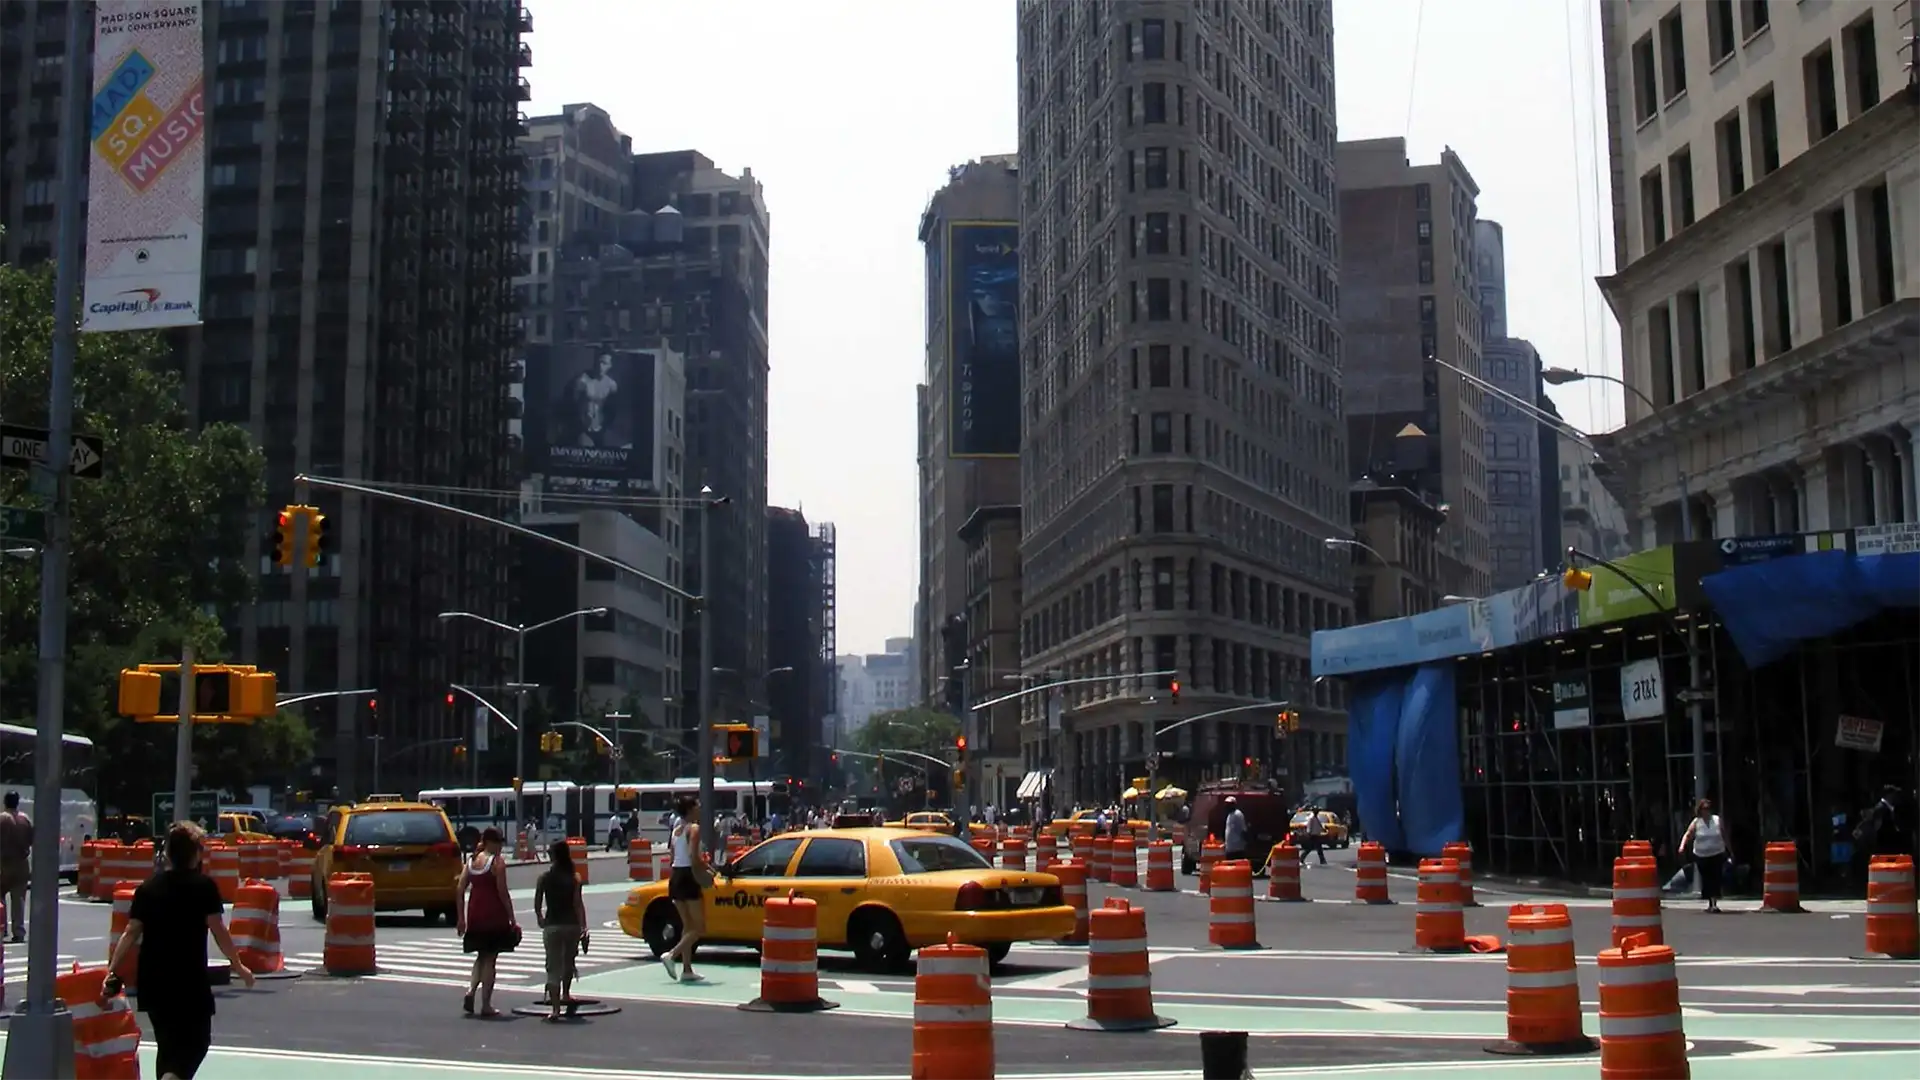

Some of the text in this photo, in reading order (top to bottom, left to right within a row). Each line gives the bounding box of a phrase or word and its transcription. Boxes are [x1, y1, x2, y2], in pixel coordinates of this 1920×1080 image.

[101, 6, 198, 24] MADISON SQUARE
[101, 18, 197, 34] PARK CONSERVANCY
[129, 93, 205, 181] MUSIC
[12, 440, 41, 457] ONE
